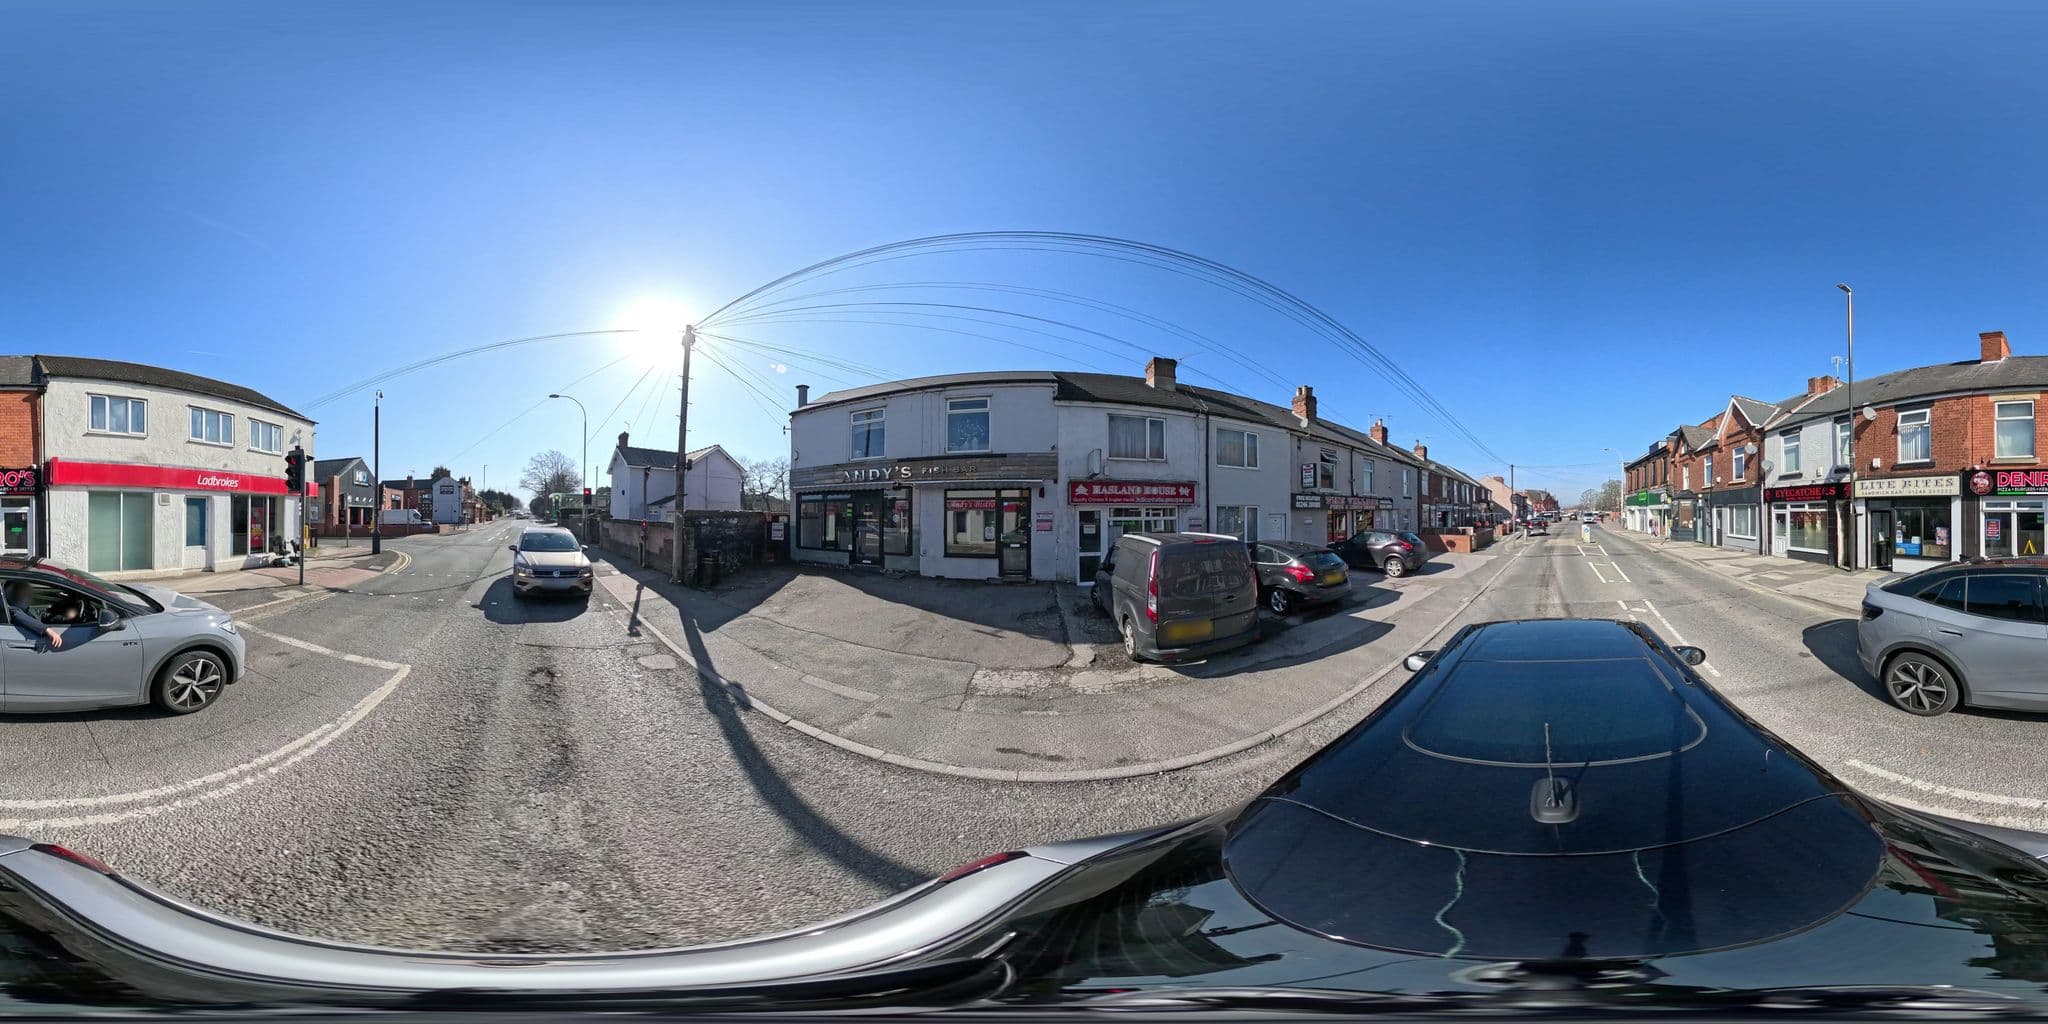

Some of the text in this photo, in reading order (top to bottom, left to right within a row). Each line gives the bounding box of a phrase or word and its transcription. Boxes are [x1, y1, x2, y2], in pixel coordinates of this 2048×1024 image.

[843, 466, 912, 481] ANDY'S
[197, 474, 240, 488] Ladbrokes
[1861, 479, 1953, 490] LITE BITES
[1092, 485, 1177, 496] HASLAND HOUSE
